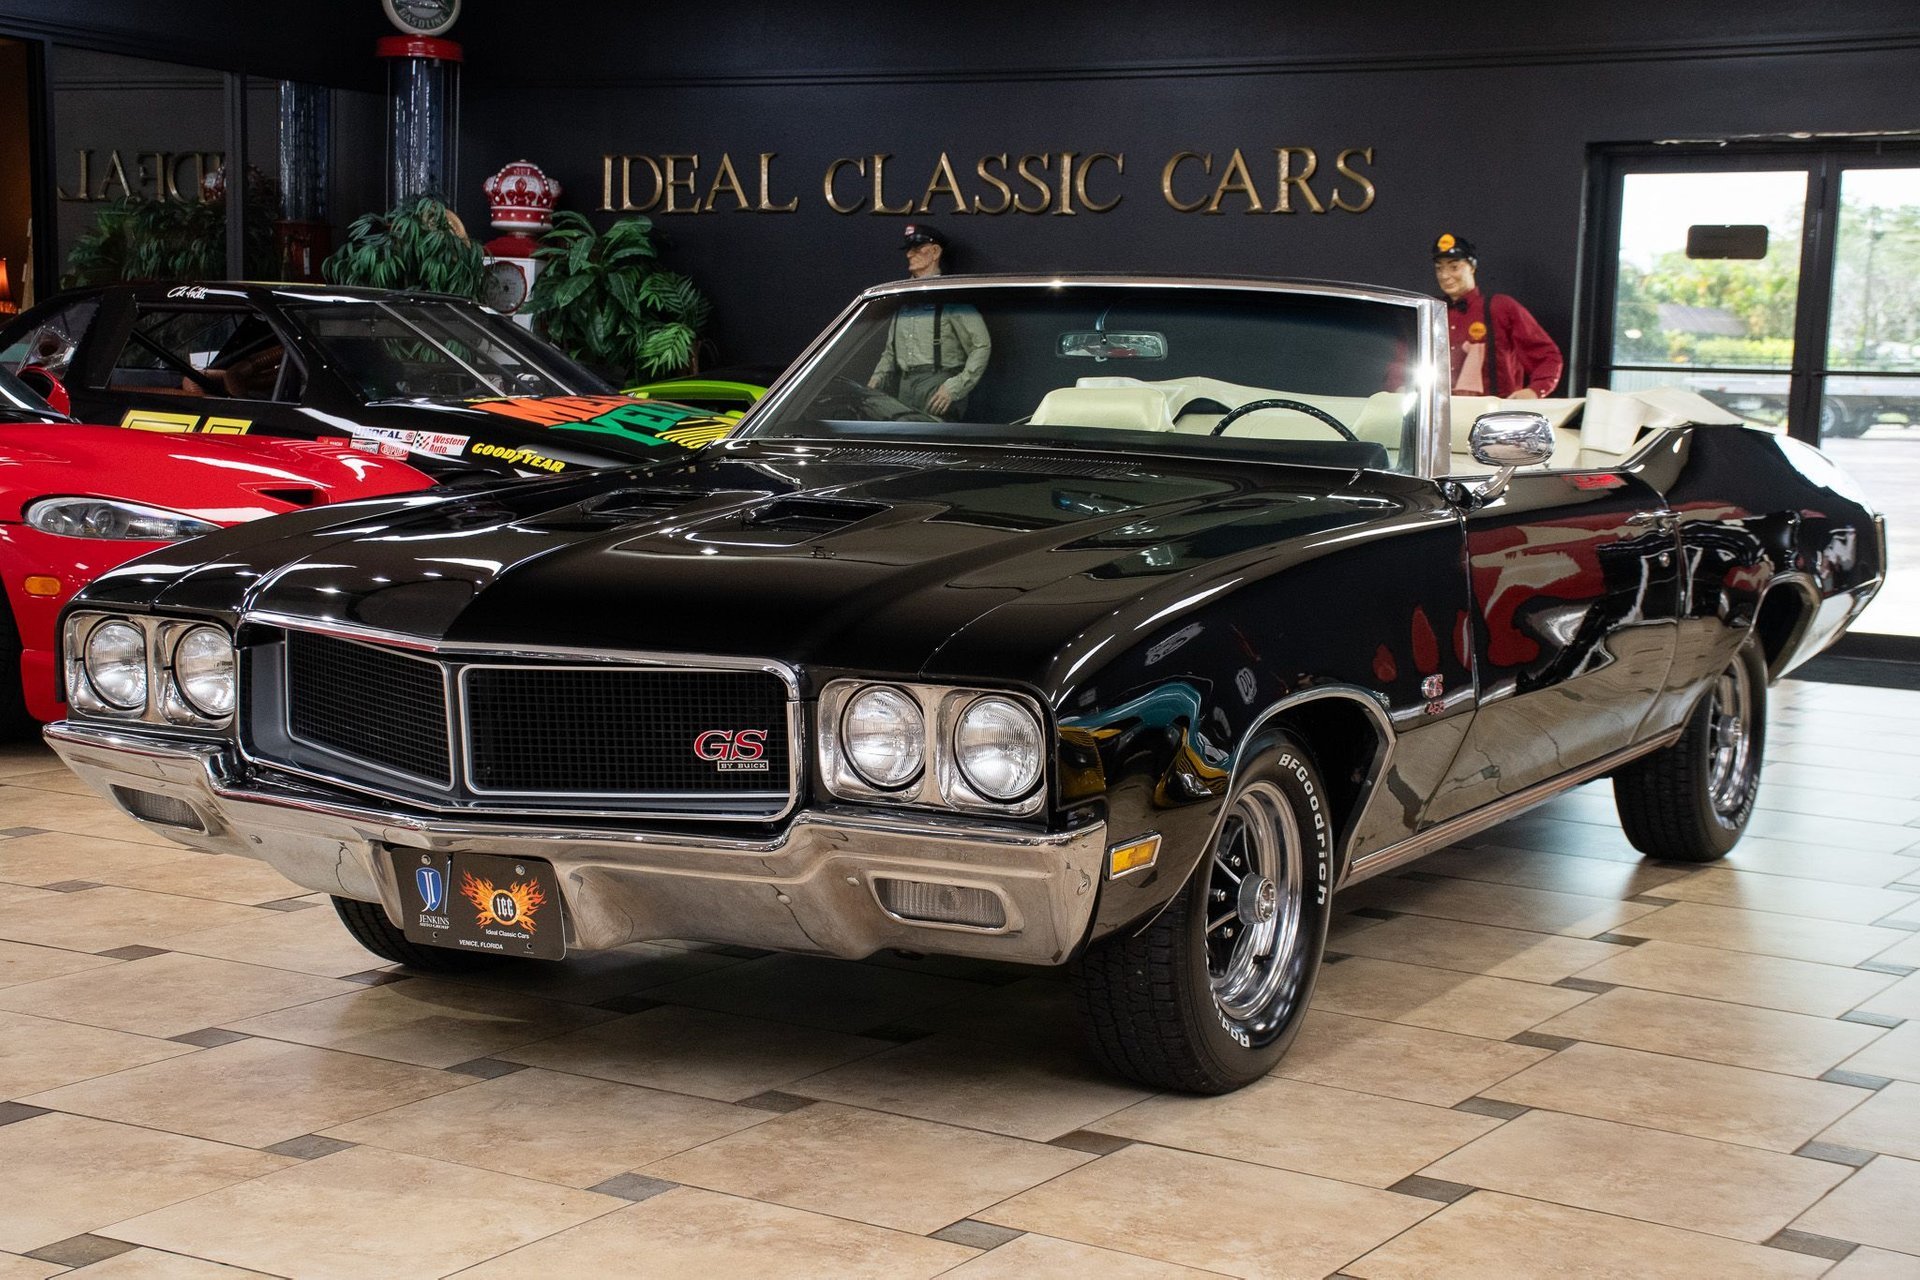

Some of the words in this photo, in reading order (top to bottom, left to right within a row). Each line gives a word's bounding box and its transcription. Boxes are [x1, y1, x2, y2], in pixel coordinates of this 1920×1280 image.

[602, 151, 798, 214] IDEAL
[823, 150, 1125, 216] CLASSIC
[1161, 146, 1376, 215] CARS
[432, 434, 467, 446] Western
[471, 442, 566, 473] GOODYEAR
[693, 729, 768, 761] GS
[1279, 753, 1327, 905] BFGoodrich
[419, 914, 450, 926] JENKINS
[485, 928, 498, 936] Ideal
[498, 930, 516, 938] Classic
[517, 931, 530, 940] Cars
[480, 941, 504, 950] FLORIDA
